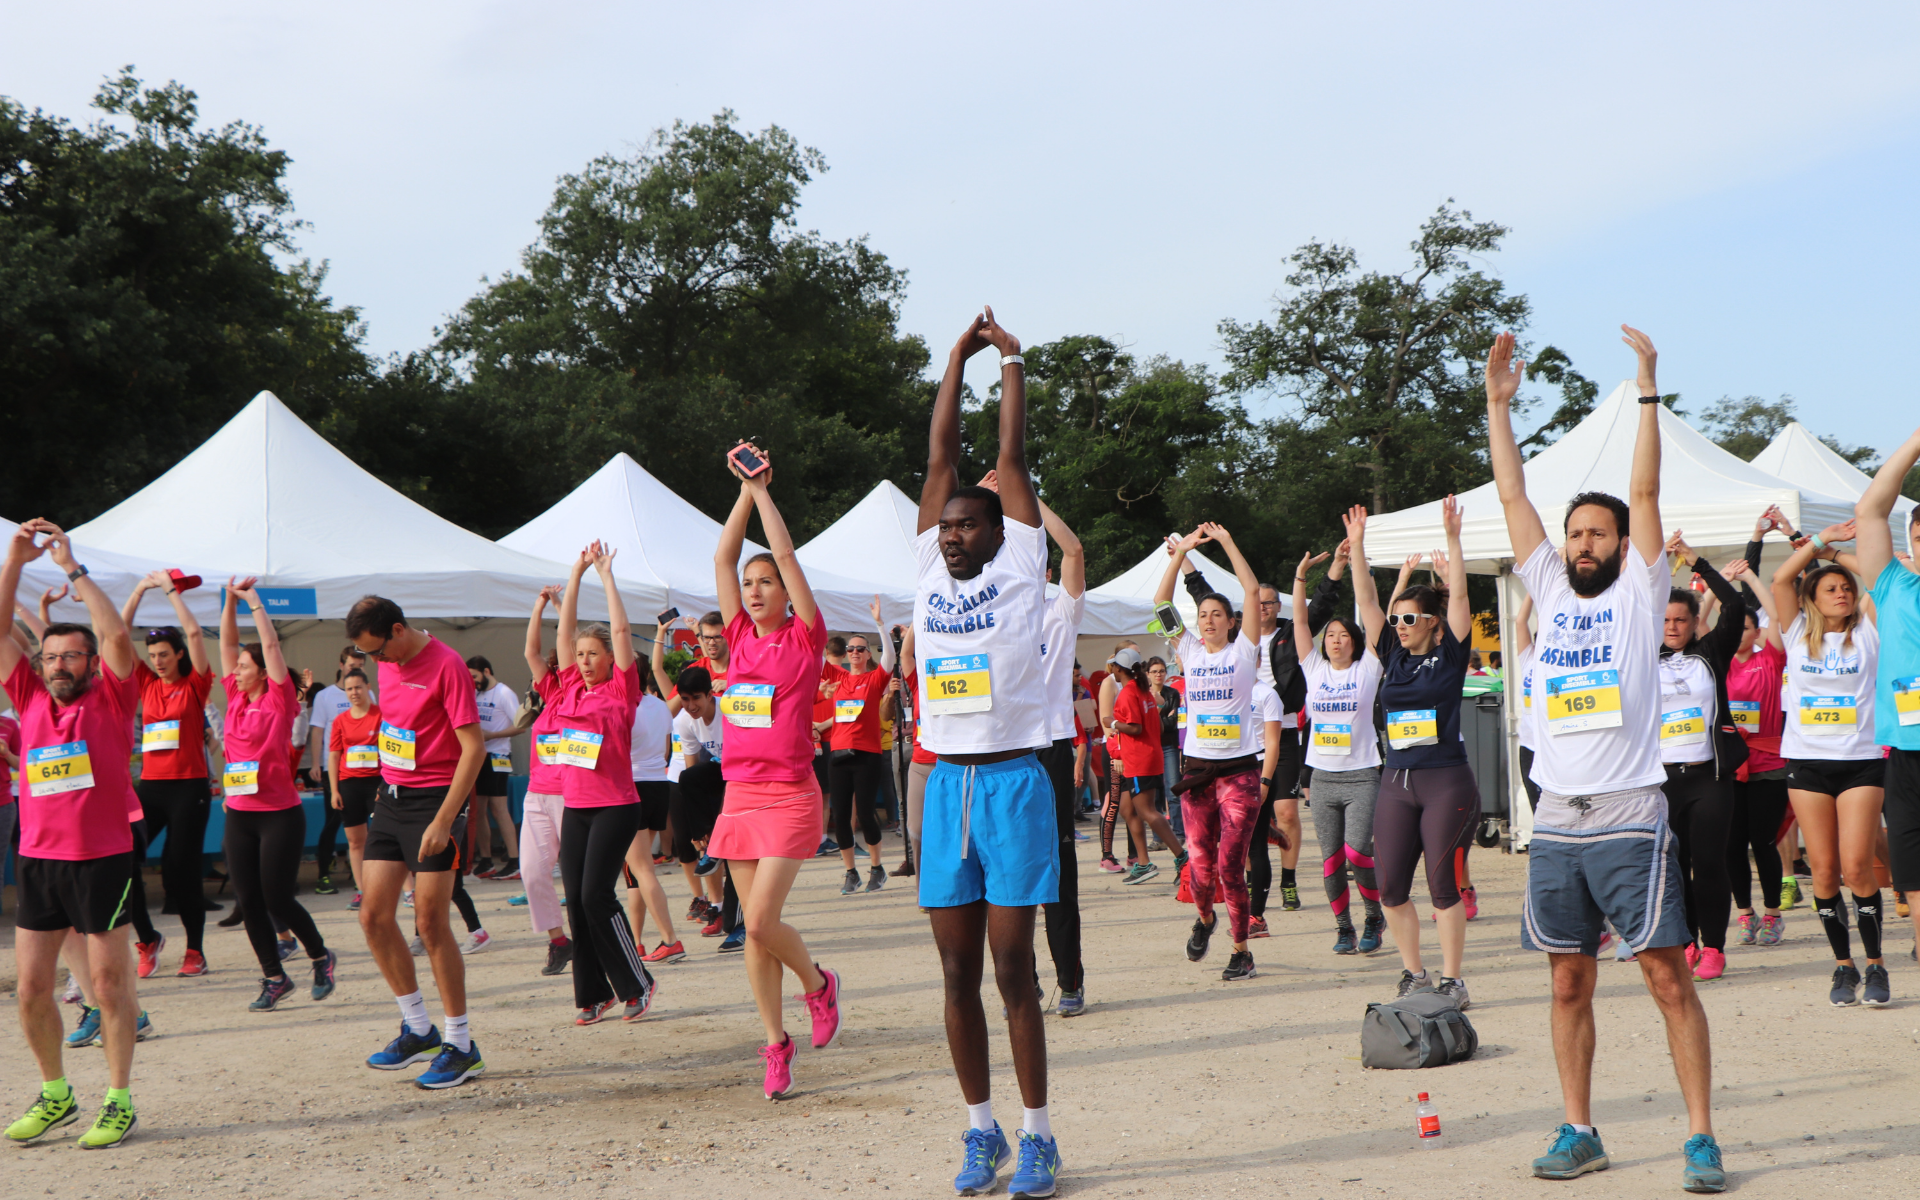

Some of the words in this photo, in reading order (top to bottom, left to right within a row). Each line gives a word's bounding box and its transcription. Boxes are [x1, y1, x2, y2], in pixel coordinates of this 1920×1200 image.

[924, 612, 995, 634] NSEMBLE
[1540, 645, 1612, 668] NSEMBLE
[1210, 665, 1234, 676] TALAN
[1835, 664, 1859, 675] TEAM
[1202, 676, 1234, 688] SPORT
[1562, 679, 1596, 689] ENSEMBLE
[1567, 675, 1588, 683] SPORT
[941, 679, 968, 694] 162
[1189, 689, 1233, 701] ENSEMBLE
[733, 701, 756, 711] 656
[1313, 702, 1358, 711] ENSEMBLE
[1565, 695, 1596, 712] 169
[1732, 714, 1747, 722] 50
[1814, 712, 1840, 722] 473
[1208, 728, 1227, 737] 124
[1403, 725, 1418, 735] 53
[1668, 723, 1692, 734] 436
[1322, 736, 1339, 744] 180
[386, 741, 402, 754] 657
[568, 744, 588, 755] 646
[42, 763, 71, 778] 647
[231, 775, 247, 784] 645
[1106, 802, 1119, 822] ROXY
